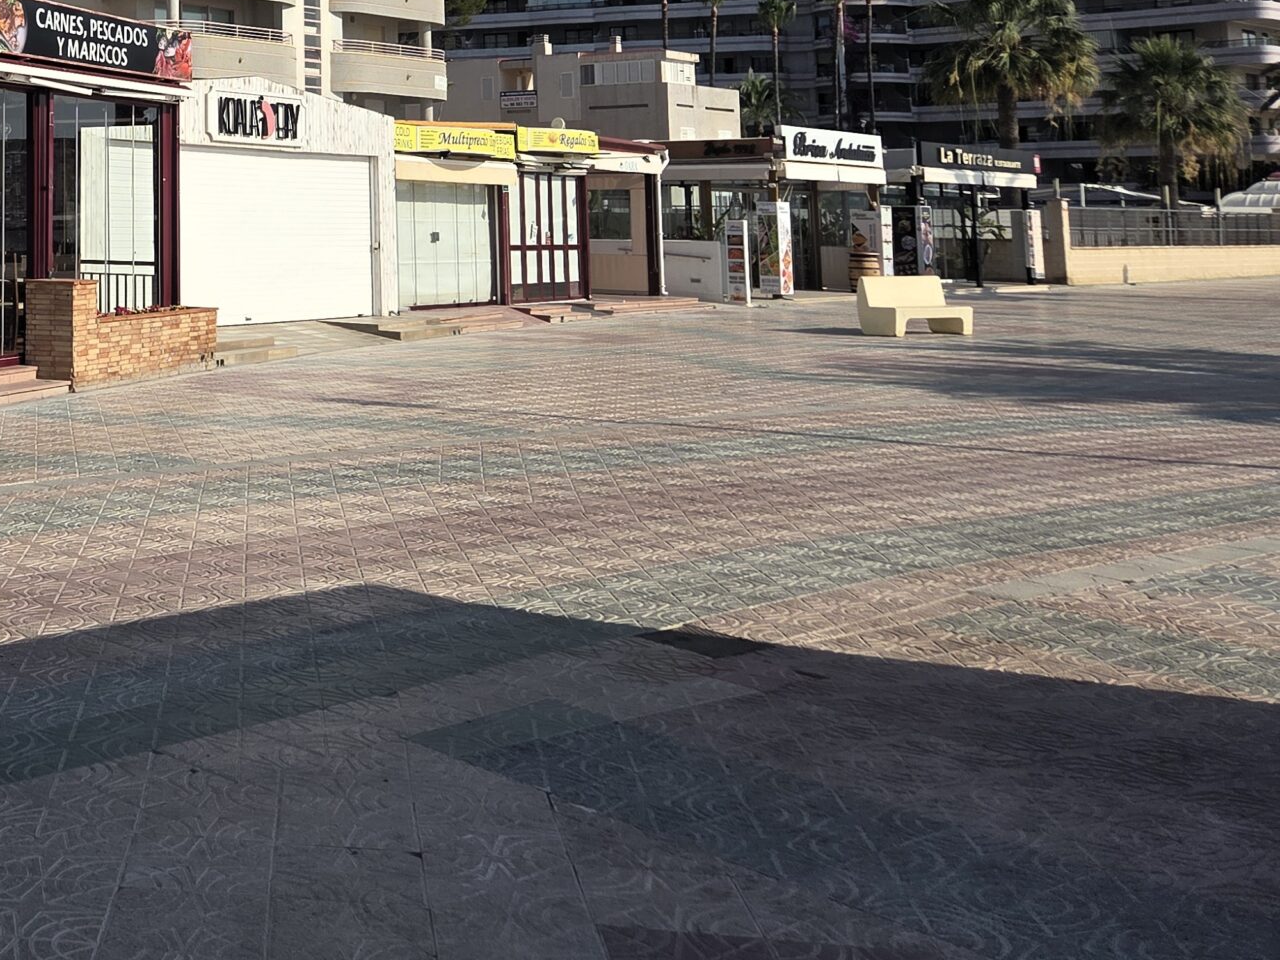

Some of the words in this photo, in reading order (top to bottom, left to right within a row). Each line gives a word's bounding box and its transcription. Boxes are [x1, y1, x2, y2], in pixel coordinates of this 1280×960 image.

[35, 7, 87, 39] CARNES,
[90, 19, 148, 47] PESCADOS
[56, 36, 65, 56] Y
[67, 39, 128, 66] MARISCOS
[218, 96, 261, 138] KOALA
[395, 126, 410, 137] COLD
[559, 133, 587, 149] Regalos
[940, 147, 954, 164] La
[955, 148, 993, 167] Terraza
